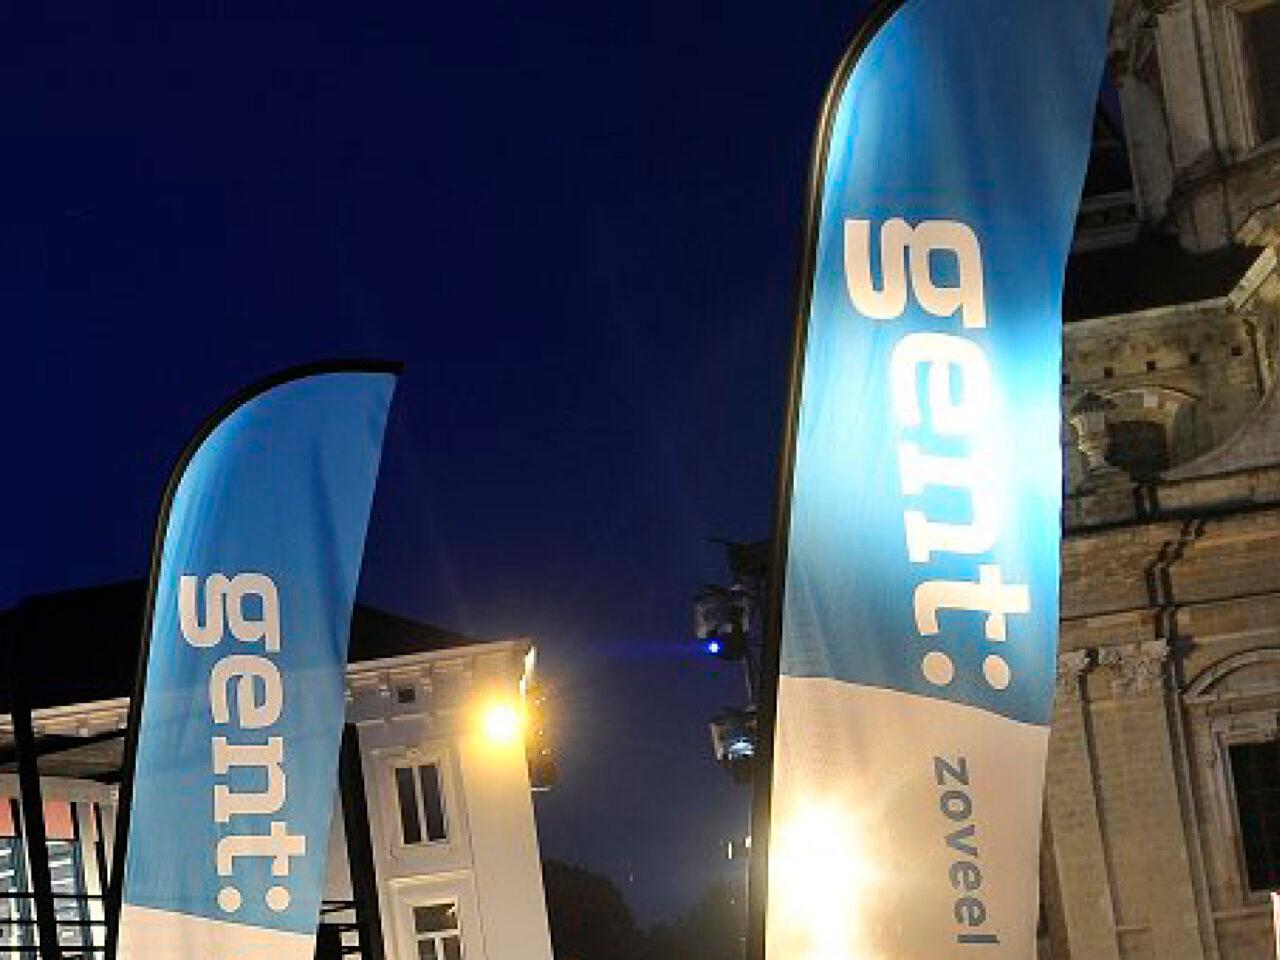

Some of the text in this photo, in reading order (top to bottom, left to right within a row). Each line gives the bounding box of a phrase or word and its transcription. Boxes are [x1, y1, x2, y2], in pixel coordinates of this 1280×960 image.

[843, 216, 1032, 691] gent:
[178, 572, 306, 914] gent:
[933, 756, 1000, 946] zoveel
